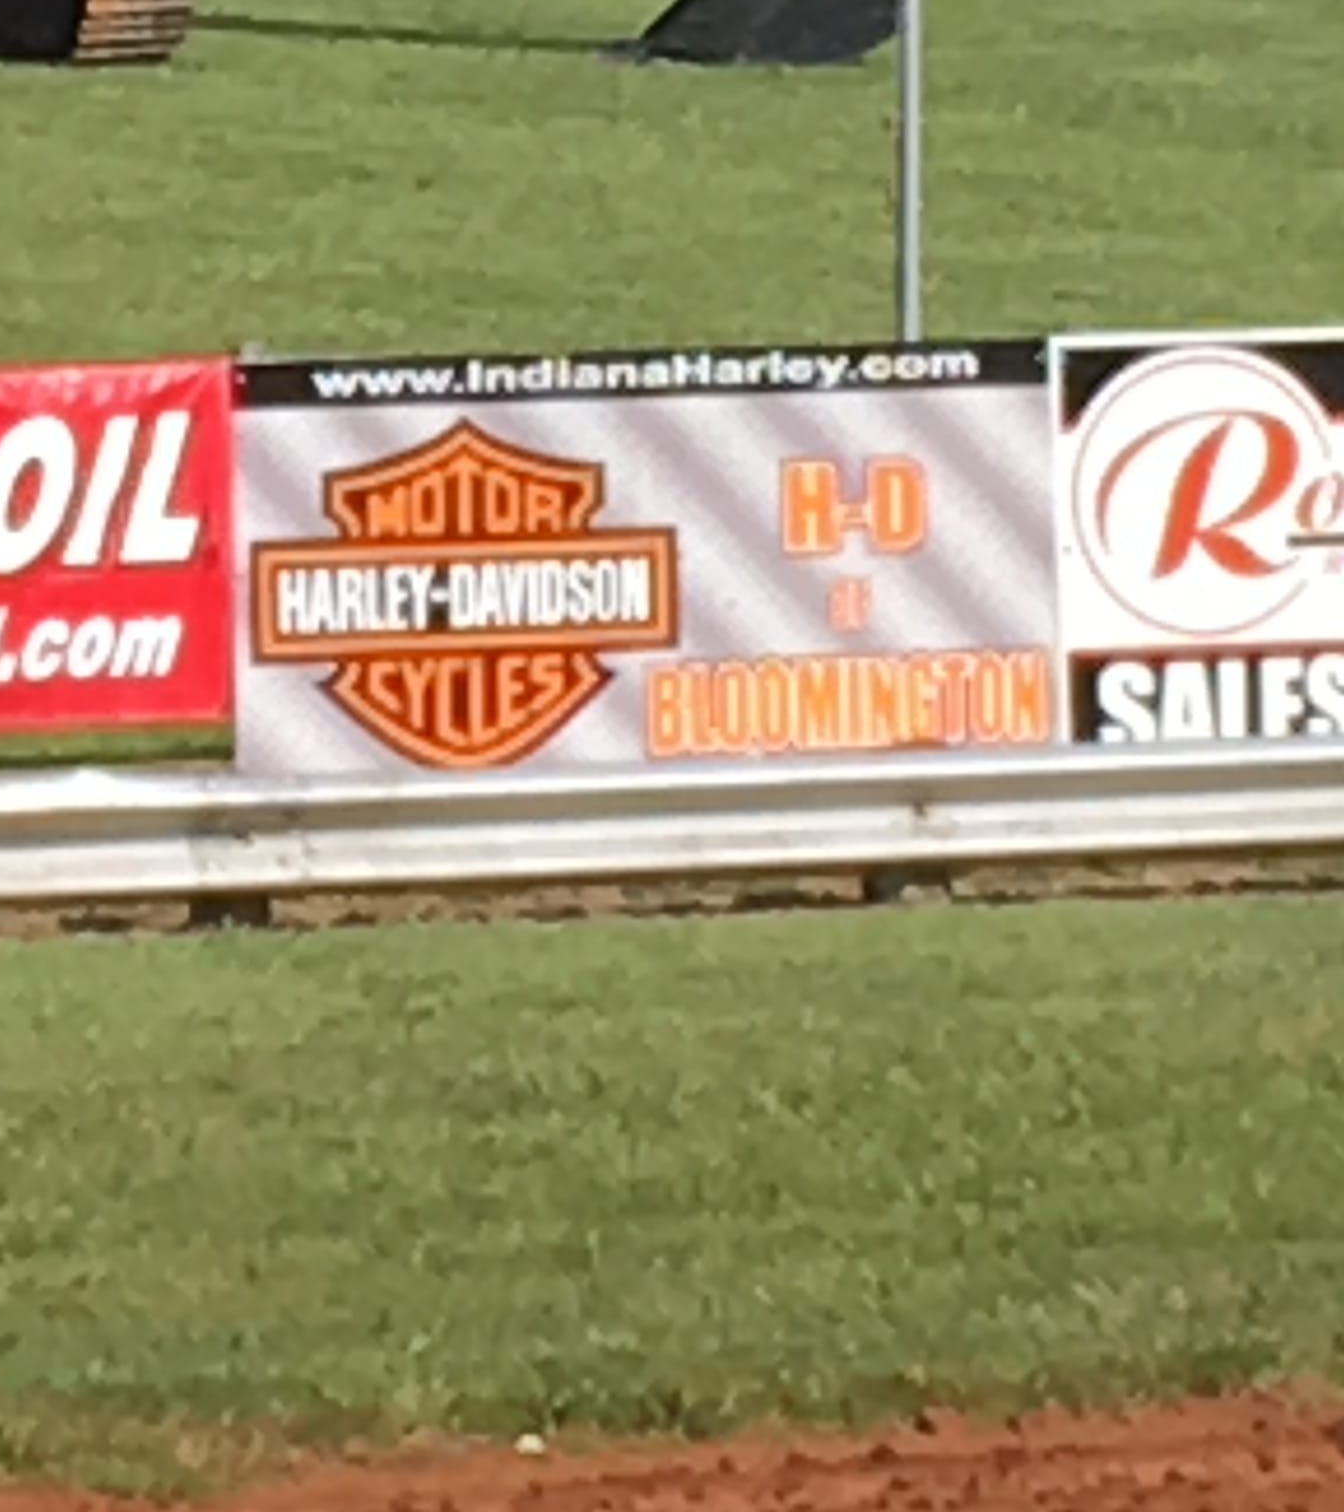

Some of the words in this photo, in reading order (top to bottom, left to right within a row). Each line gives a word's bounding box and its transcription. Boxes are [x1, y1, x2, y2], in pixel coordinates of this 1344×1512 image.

[311, 349, 980, 398] www.IndianaHarley.com
[365, 455, 566, 538] MOTOR
[780, 458, 929, 556] H-D
[276, 557, 651, 636] HARLEY-DAVIDSON
[367, 653, 566, 746] CYCLES
[650, 650, 1050, 757] BLOOMINGTON
